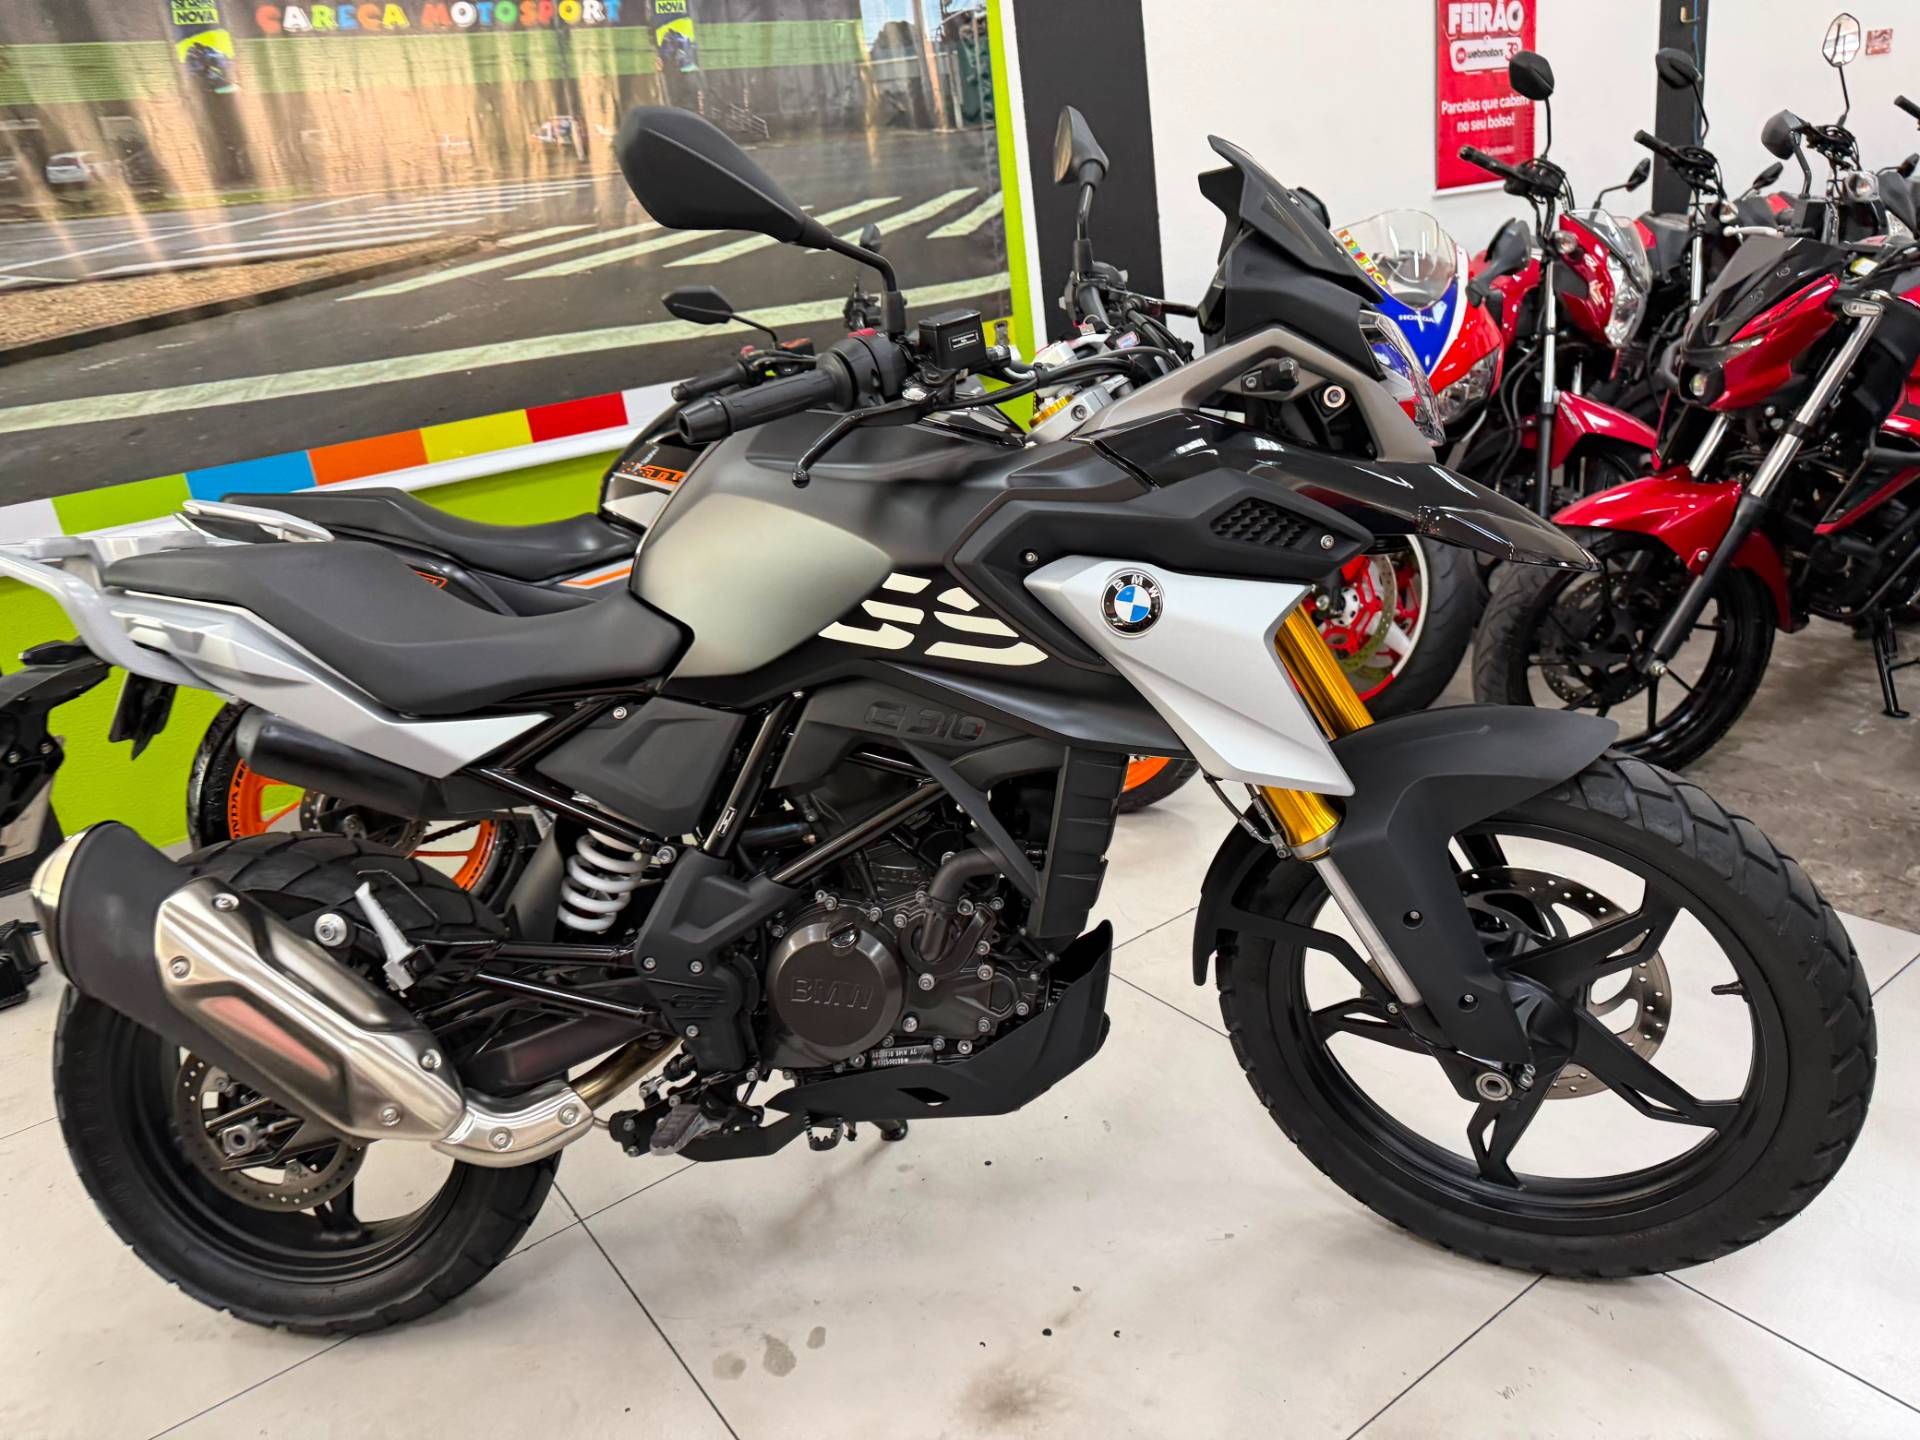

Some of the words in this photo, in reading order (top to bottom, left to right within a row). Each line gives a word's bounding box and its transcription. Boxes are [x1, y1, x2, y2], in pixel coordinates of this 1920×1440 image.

[255, 3, 410, 33] CARECA
[420, 0, 620, 27] MOTOSPORT
[1448, 0, 1524, 34] FEIRÃO
[1441, 99, 1480, 115] Parcelas
[1481, 98, 1498, 113] que
[1457, 121, 1469, 132] no
[1471, 119, 1486, 131] seu
[1487, 112, 1515, 128] bolso!
[1398, 314, 1435, 322] HONDA
[907, 708, 986, 742] 310
[792, 977, 873, 1010] BMW
